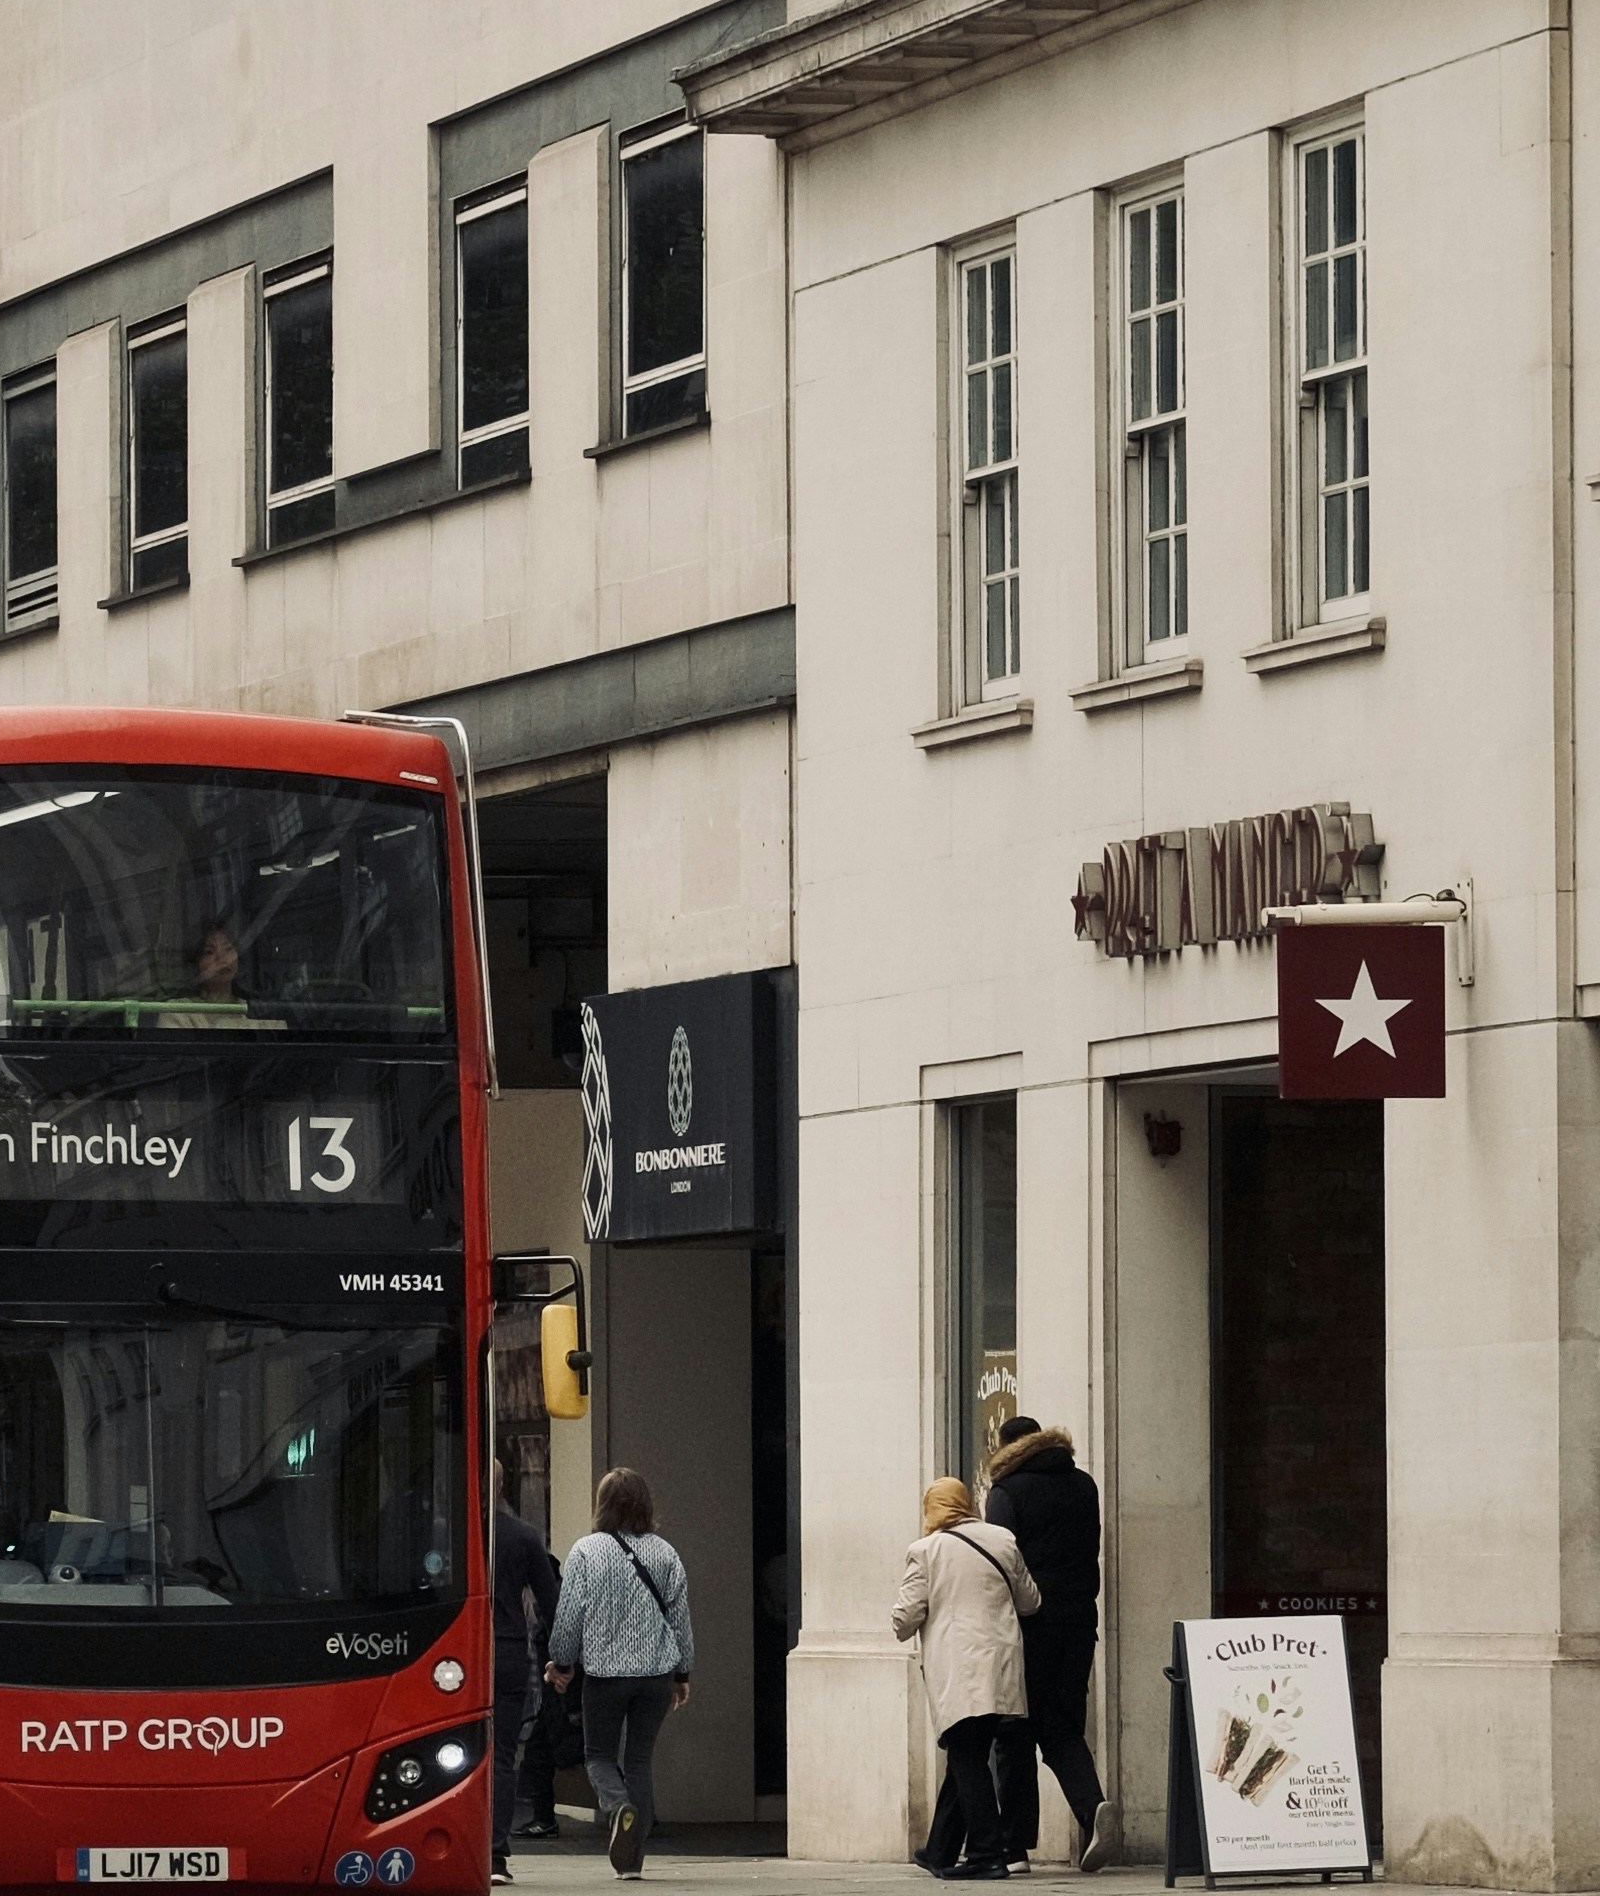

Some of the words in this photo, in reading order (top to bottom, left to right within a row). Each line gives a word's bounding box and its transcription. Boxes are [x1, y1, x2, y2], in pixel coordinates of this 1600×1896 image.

[31, 1121, 192, 1179] Finchley
[288, 1115, 357, 1194] 13
[635, 1142, 726, 1173] BONBONNIERE
[670, 1180, 692, 1194] LONDON
[338, 1273, 385, 1293] VMH
[389, 1273, 445, 1293] 45341
[980, 1366, 1001, 1401] Club
[1277, 1597, 1359, 1611] COOKIES
[1215, 1634, 1266, 1662] Club
[1272, 1633, 1320, 1658] Pret
[20, 1720, 128, 1753] RATP
[137, 1716, 285, 1757] GROUP
[1307, 1764, 1328, 1775] Get
[1285, 1791, 1302, 1810] &
[1330, 1795, 1349, 1809] off
[1309, 1784, 1345, 1796] drinks
[1302, 1808, 1331, 1818] entire
[101, 1852, 161, 1878] LJ17
[168, 1852, 220, 1877] WSD
